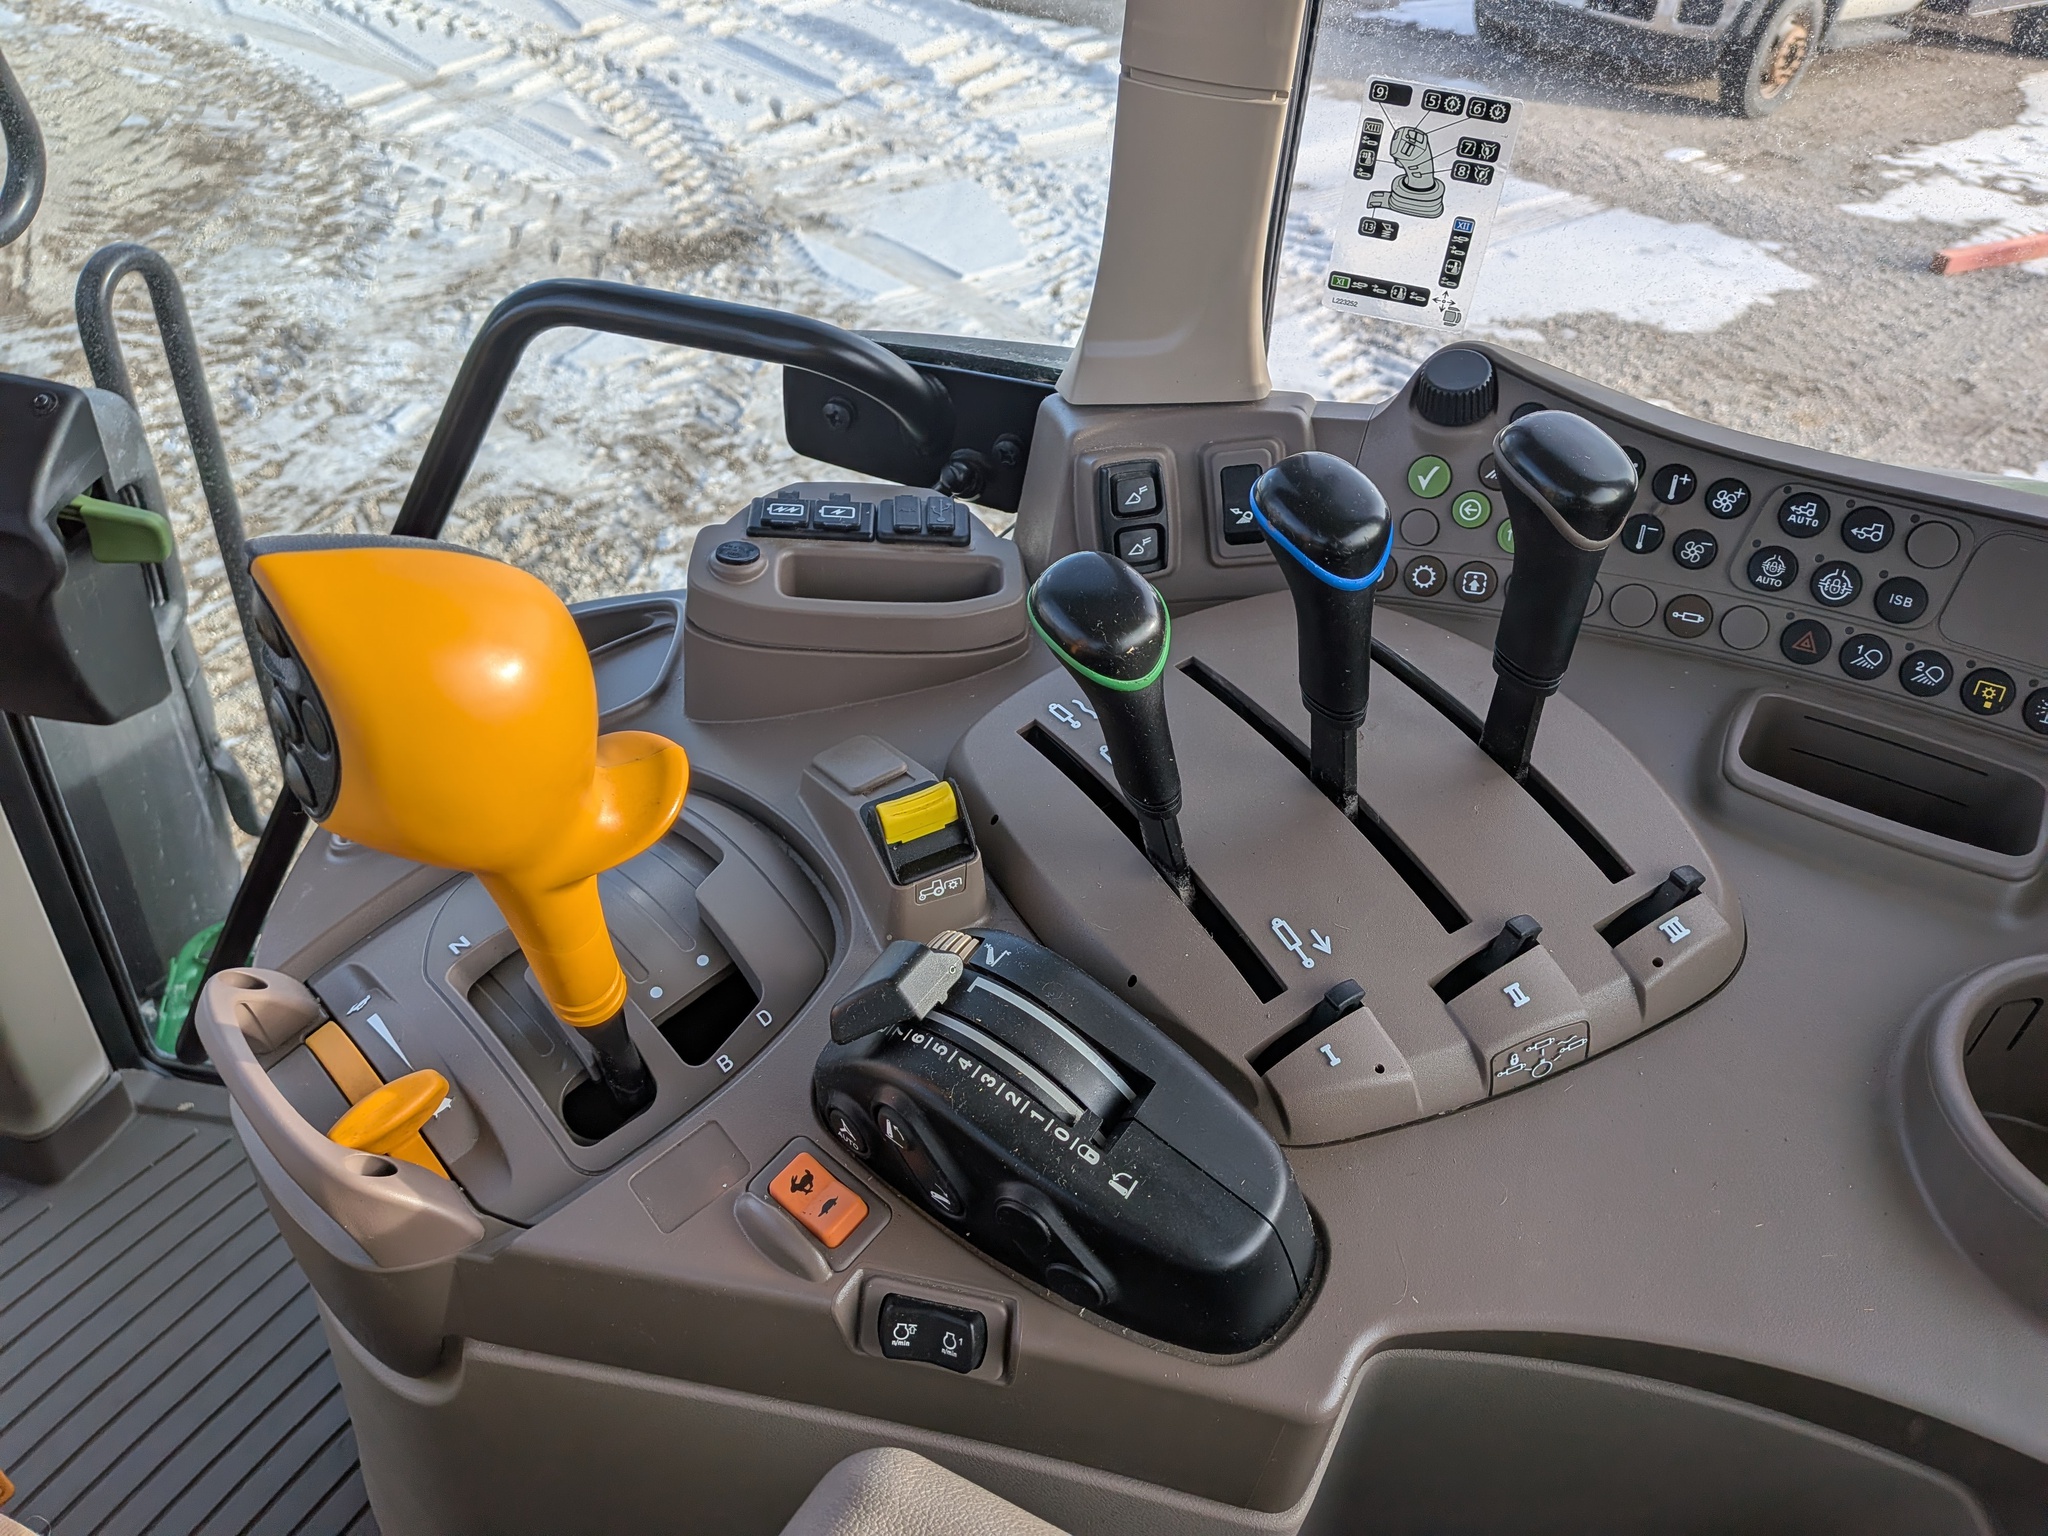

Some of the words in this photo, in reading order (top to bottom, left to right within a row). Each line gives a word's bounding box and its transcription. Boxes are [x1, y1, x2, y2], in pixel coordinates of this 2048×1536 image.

[1376, 86, 1385, 98] 9
[1427, 95, 1437, 107] 5
[1473, 103, 1482, 115] 6
[1365, 123, 1380, 133] XIII
[1464, 142, 1473, 153] 7
[1457, 165, 1466, 177] 8
[1364, 222, 1374, 231] 13
[1456, 221, 1471, 231] XII
[1336, 277, 1346, 286] XI
[1787, 514, 1819, 528] AUTO
[1755, 575, 1783, 588] AUTO
[1889, 593, 1914, 608] ISB
[1857, 644, 1864, 655] 1
[1915, 661, 1925, 672] 2
[1658, 916, 1691, 943] III
[448, 935, 471, 956] N
[1503, 982, 1530, 1007] II
[755, 1009, 773, 1028] D
[1320, 1044, 1341, 1067] I
[716, 1053, 734, 1073] B
[911, 1032, 925, 1044] 6
[932, 1042, 948, 1056] 5
[958, 1057, 973, 1070] 4
[980, 1073, 997, 1087] 3
[1004, 1091, 1022, 1107] 2
[1030, 1109, 1045, 1122] 1
[1054, 1127, 1070, 1142] 0
[837, 1131, 859, 1151] AUTO
[891, 1339, 910, 1347] n/min
[958, 1337, 964, 1347] 1
